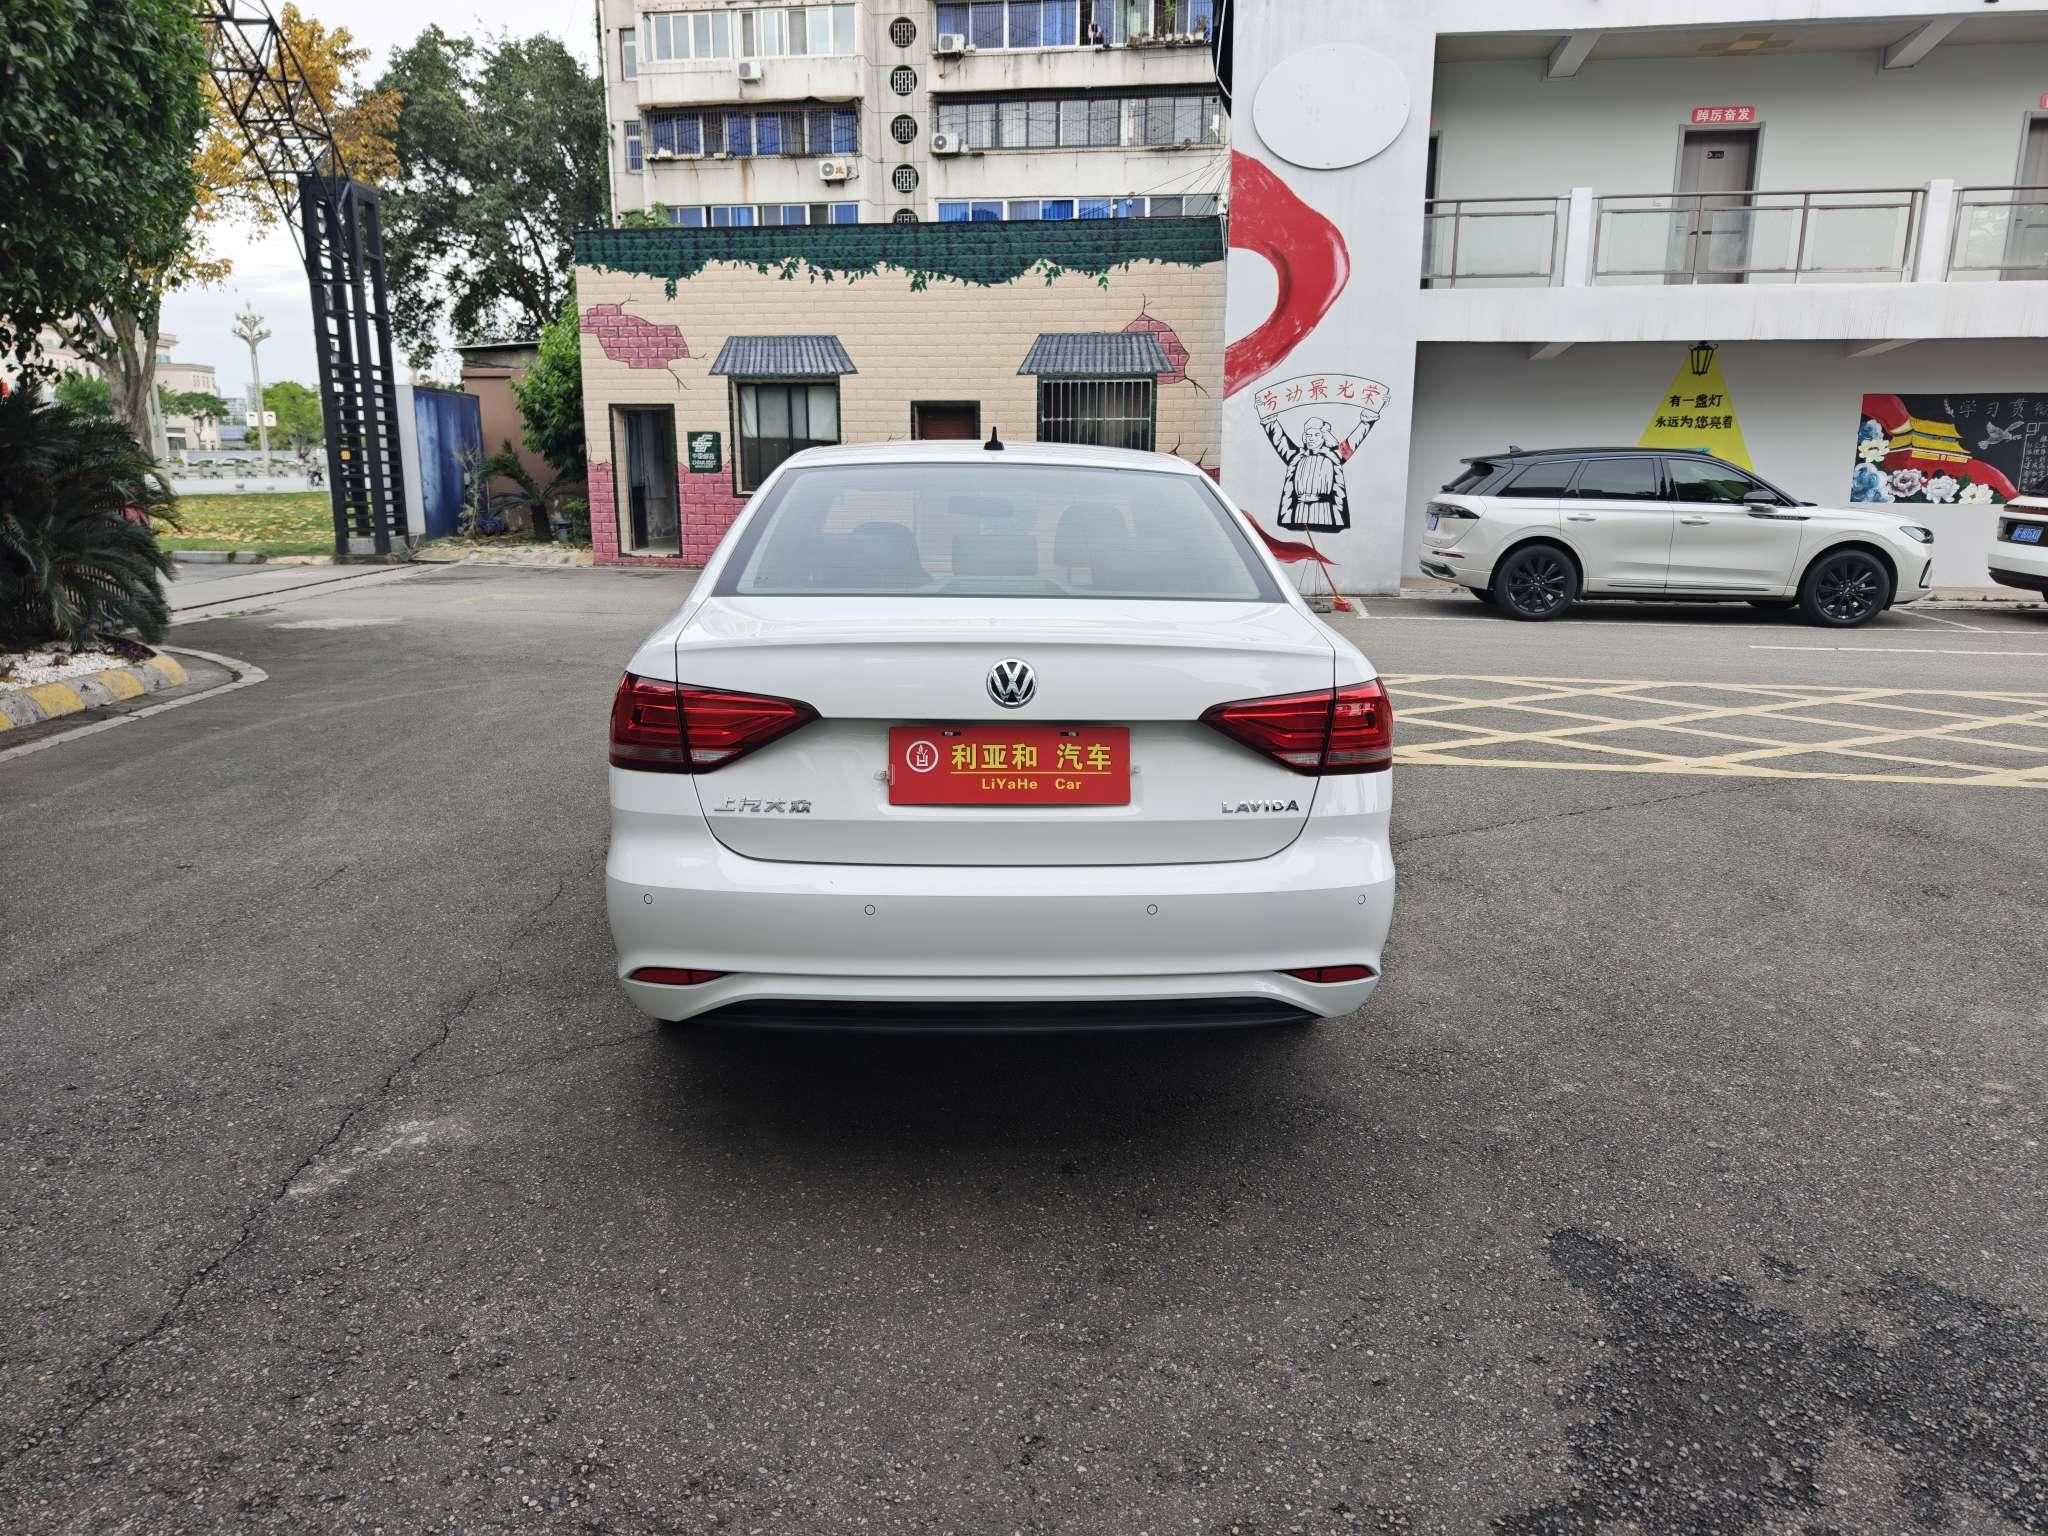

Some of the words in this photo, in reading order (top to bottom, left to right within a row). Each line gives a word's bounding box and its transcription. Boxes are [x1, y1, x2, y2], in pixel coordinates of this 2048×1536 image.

[1263, 378, 1381, 411] 劳动最光荣
[1669, 393, 1723, 409] 有一盏灯
[1655, 415, 1733, 429] 永远为您亮着
[951, 743, 1039, 770] 利亚和
[1056, 743, 1112, 771] 汽车
[981, 778, 1039, 790] LiYaHe
[1055, 778, 1082, 790] Car
[713, 797, 812, 813] 上汽大众
[1221, 800, 1299, 814] LAVIDA
